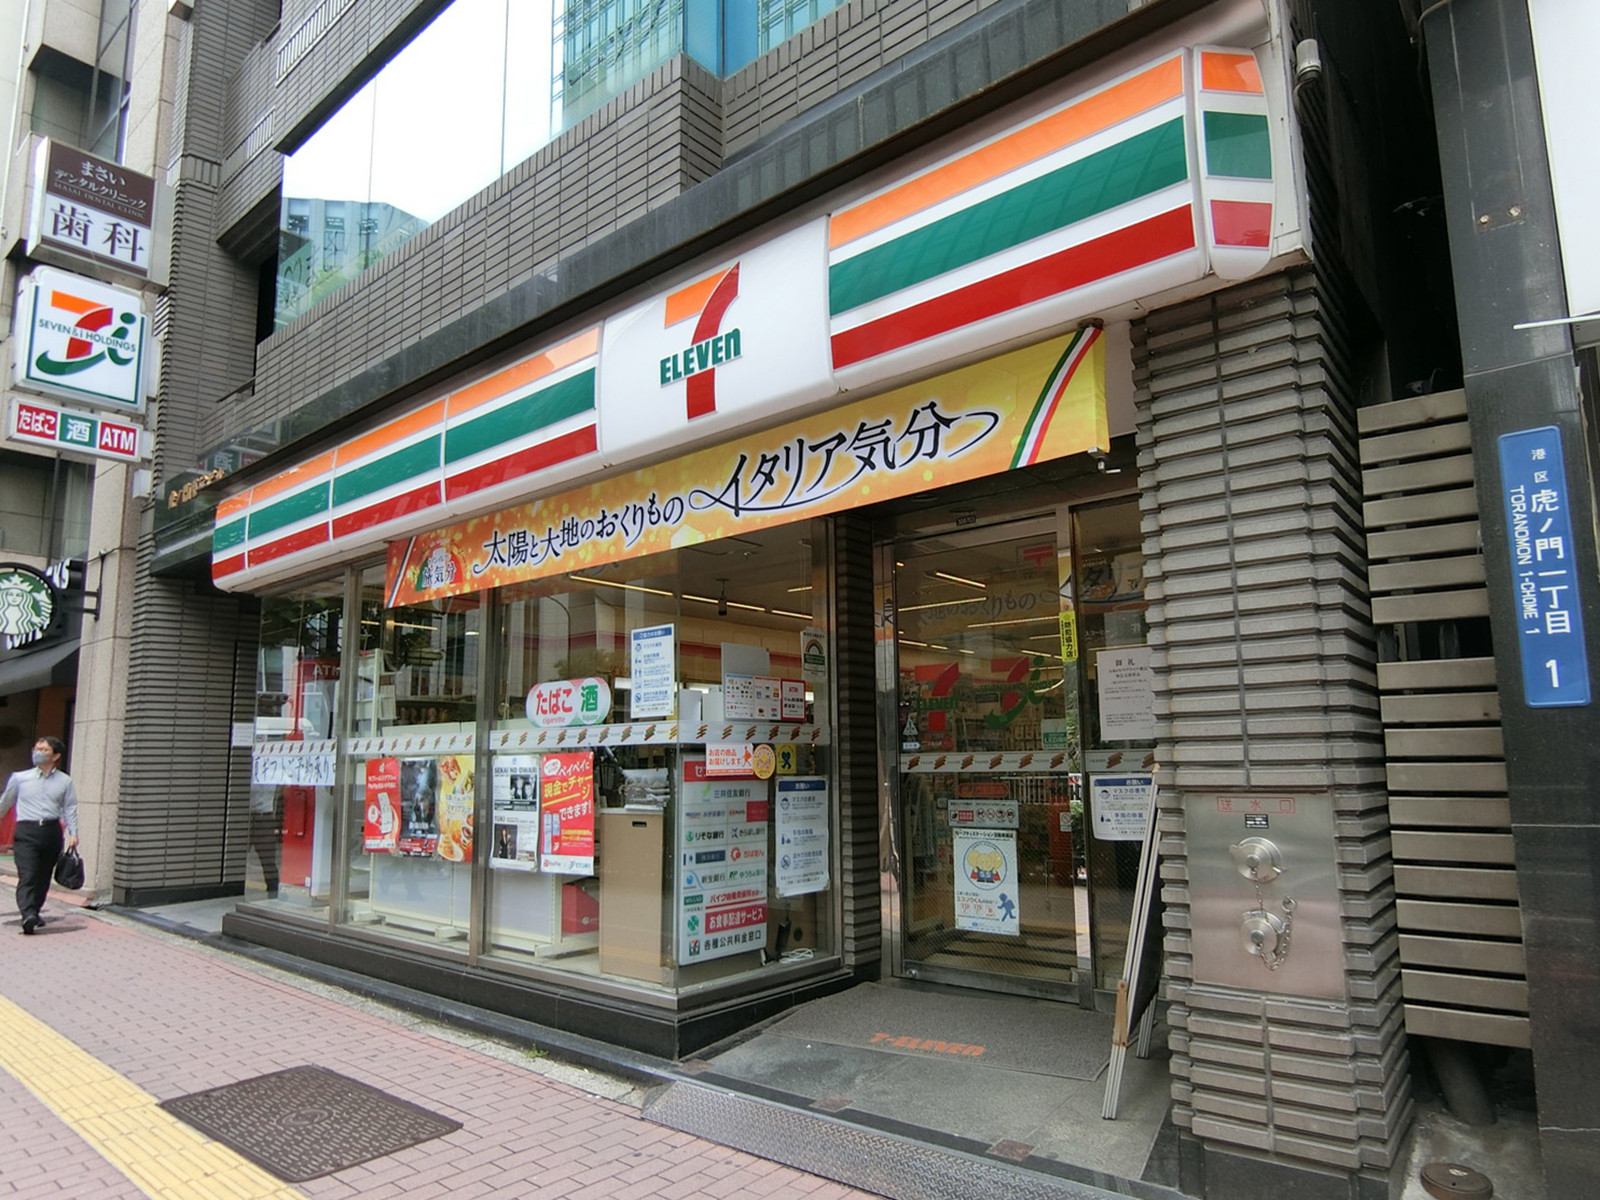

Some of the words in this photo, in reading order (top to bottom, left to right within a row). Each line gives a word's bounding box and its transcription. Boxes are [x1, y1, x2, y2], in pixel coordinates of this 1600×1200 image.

[55, 169, 147, 209] デンタルクリニック
[81, 161, 126, 186] まさい
[51, 203, 144, 262] 歯科
[86, 331, 137, 353] HOLDINGS
[18, 409, 57, 435] たばこ
[67, 419, 91, 445] 酒
[101, 429, 135, 452] ATM
[689, 401, 999, 518] イタリア気分
[1531, 447, 1550, 483] 港区
[473, 493, 685, 575] 太陽と大地のおくりもの
[1509, 485, 1533, 566] TORANOMON
[1531, 488, 1572, 635] 虎ノ門一丁目
[1519, 570, 1539, 619] 1-CHOME
[1525, 627, 1541, 635] 1
[1545, 659, 1560, 688] 1
[536, 687, 573, 716] たばこ
[580, 685, 599, 712] 酒
[559, 760, 590, 776] ペイペイに
[695, 830, 724, 841] りそな銀行
